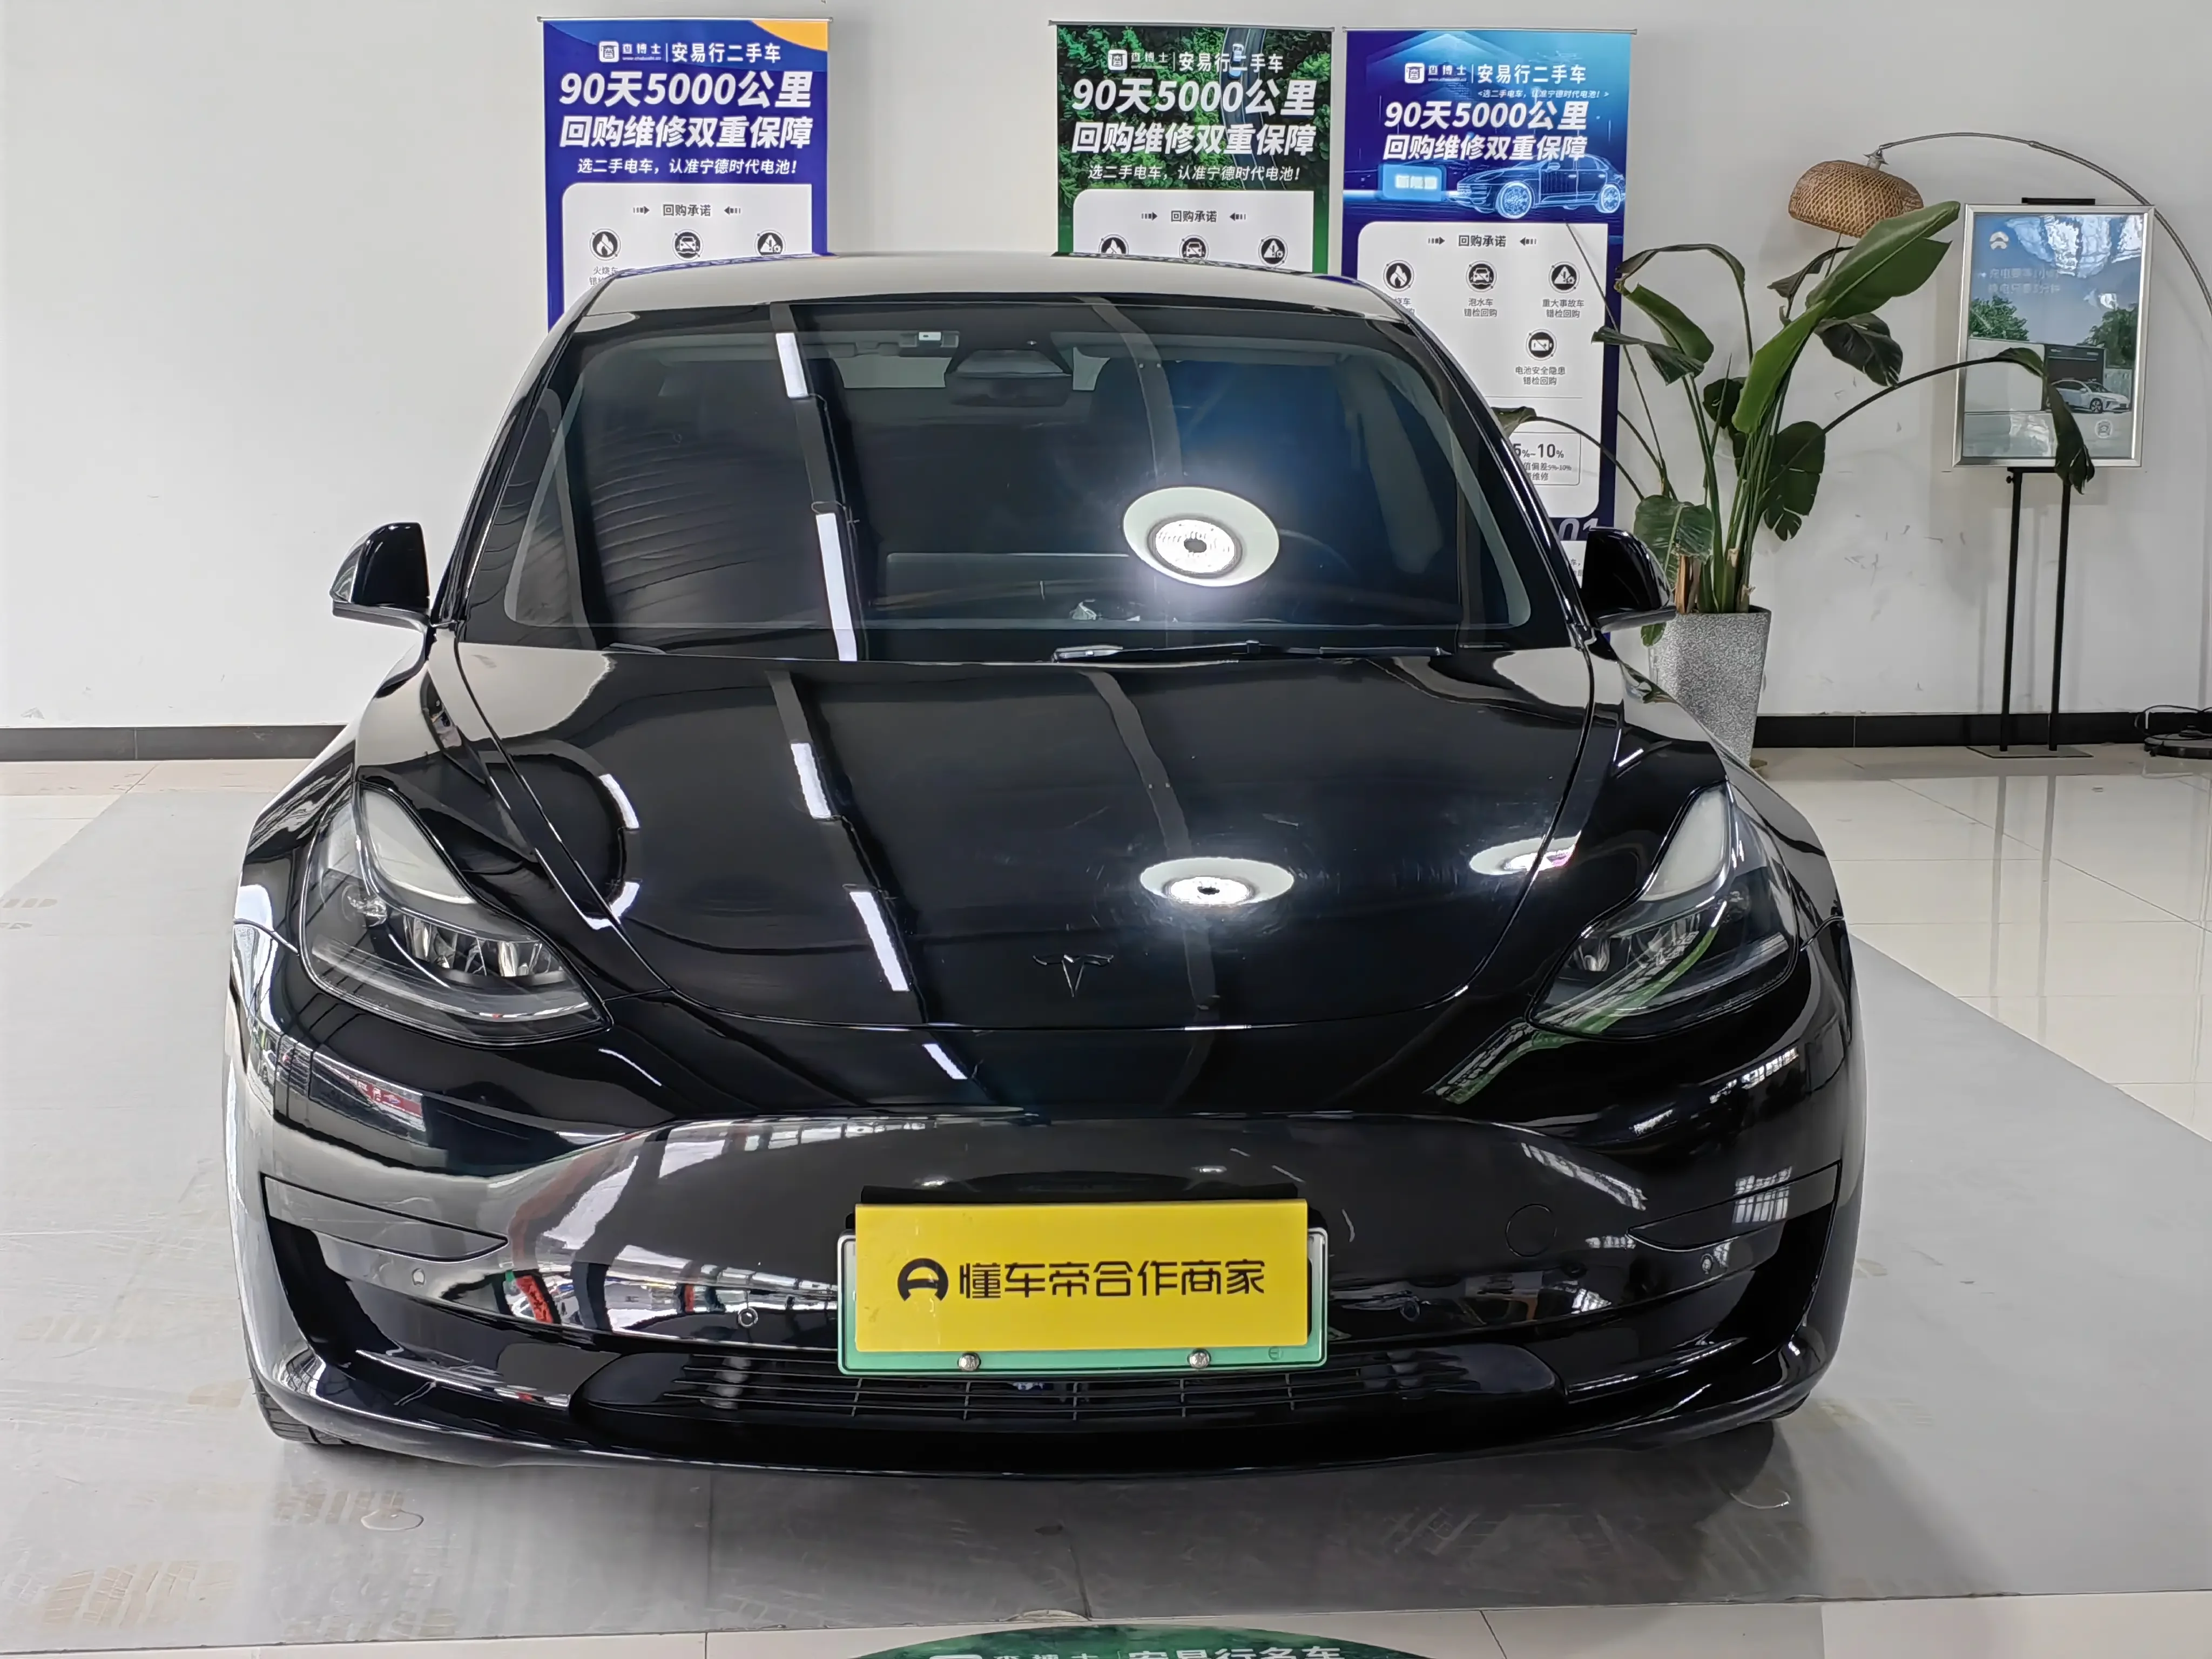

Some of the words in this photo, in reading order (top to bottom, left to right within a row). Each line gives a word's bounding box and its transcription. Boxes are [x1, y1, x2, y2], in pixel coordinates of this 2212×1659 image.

[672, 43, 781, 63] 安易行二手车
[1179, 51, 1284, 73] 安易行二手车
[1478, 64, 1586, 84] 安易行二手车
[559, 70, 813, 108] 90天5000公里
[1072, 78, 1318, 116] 90天5000公里
[1384, 101, 1589, 131] 90天5000公里
[559, 116, 813, 149] 回购维修双重保障
[1071, 122, 1317, 156] 回购维修双重保障
[1382, 134, 1588, 161] 回购维修双重保障
[663, 204, 711, 216] 回购承诺
[1170, 211, 1217, 222] 回购承诺
[1458, 235, 1506, 247] 回购承诺
[1468, 298, 1493, 307] 泡水车
[1542, 299, 1584, 308] 重大事故车
[959, 1259, 1265, 1299] 懂车帝合作商家
